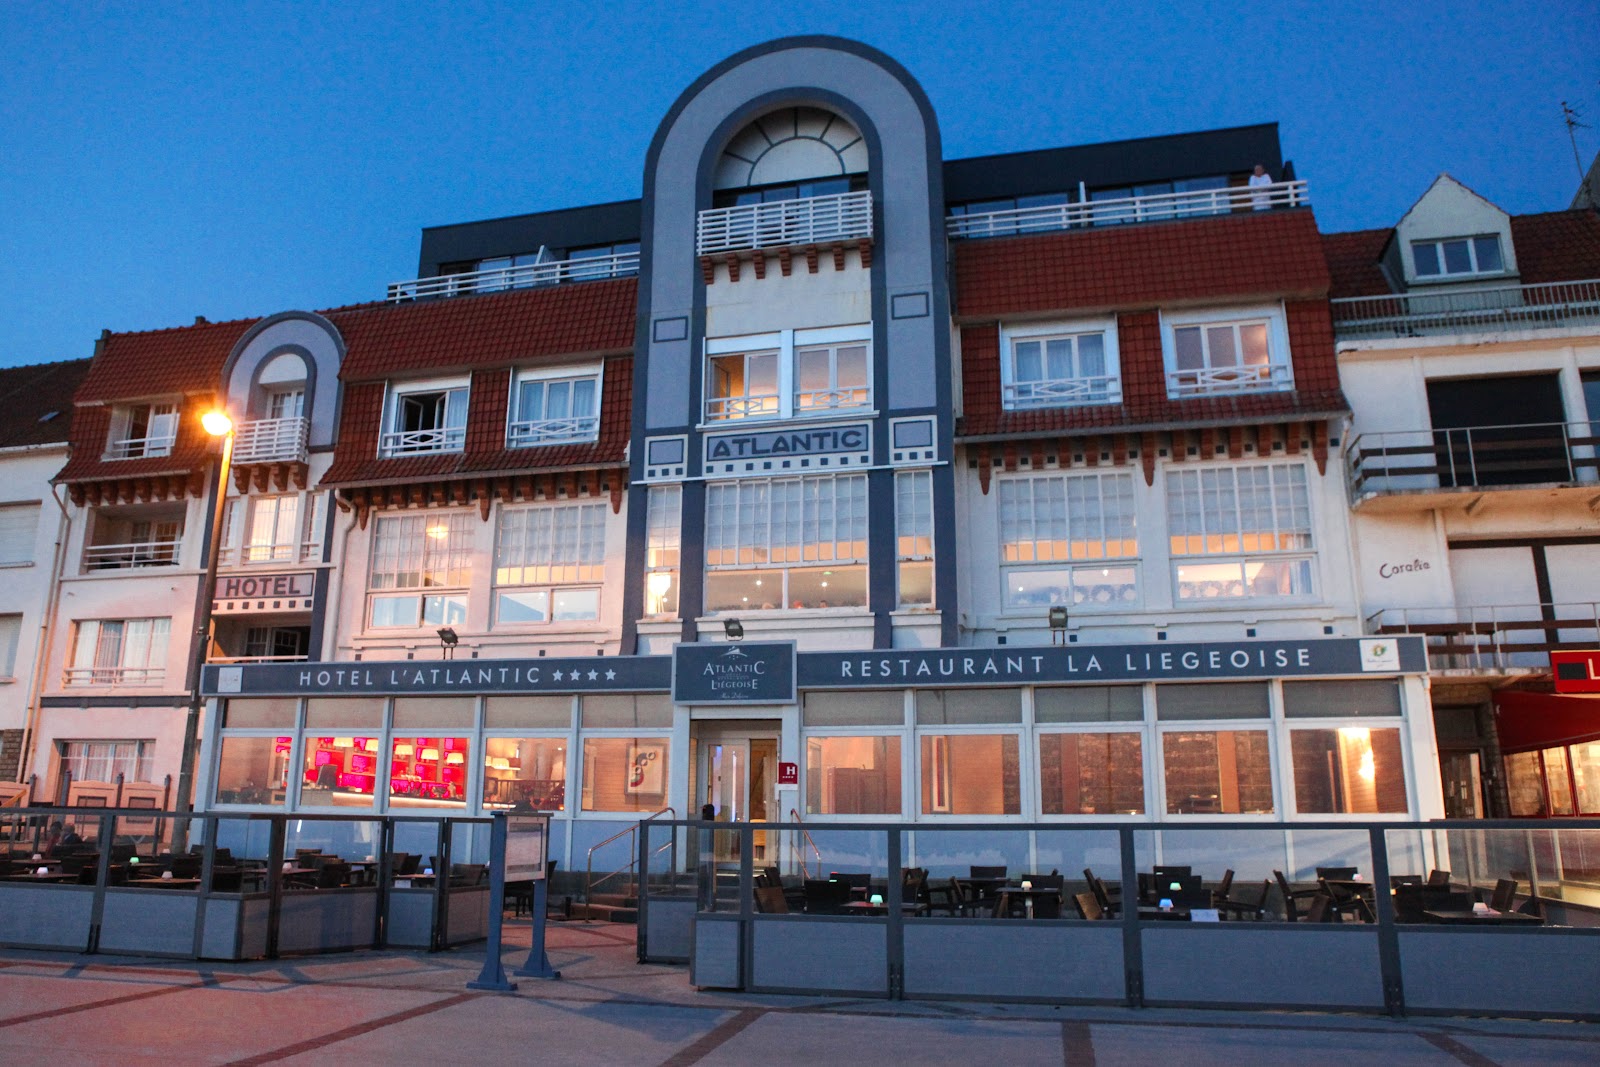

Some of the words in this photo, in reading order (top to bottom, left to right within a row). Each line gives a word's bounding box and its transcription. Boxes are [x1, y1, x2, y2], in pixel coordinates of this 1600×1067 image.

[713, 430, 862, 458] ATLANTIC
[1379, 558, 1431, 579] Coralie
[225, 576, 301, 597] HOTEL
[841, 655, 1043, 678] RESTAURANT
[1068, 653, 1103, 672] LA
[1126, 648, 1312, 671] LIEGEOISE
[300, 669, 373, 687] HOTEL
[390, 666, 541, 686] L'ATLANTIC
[786, 766, 796, 775] H
